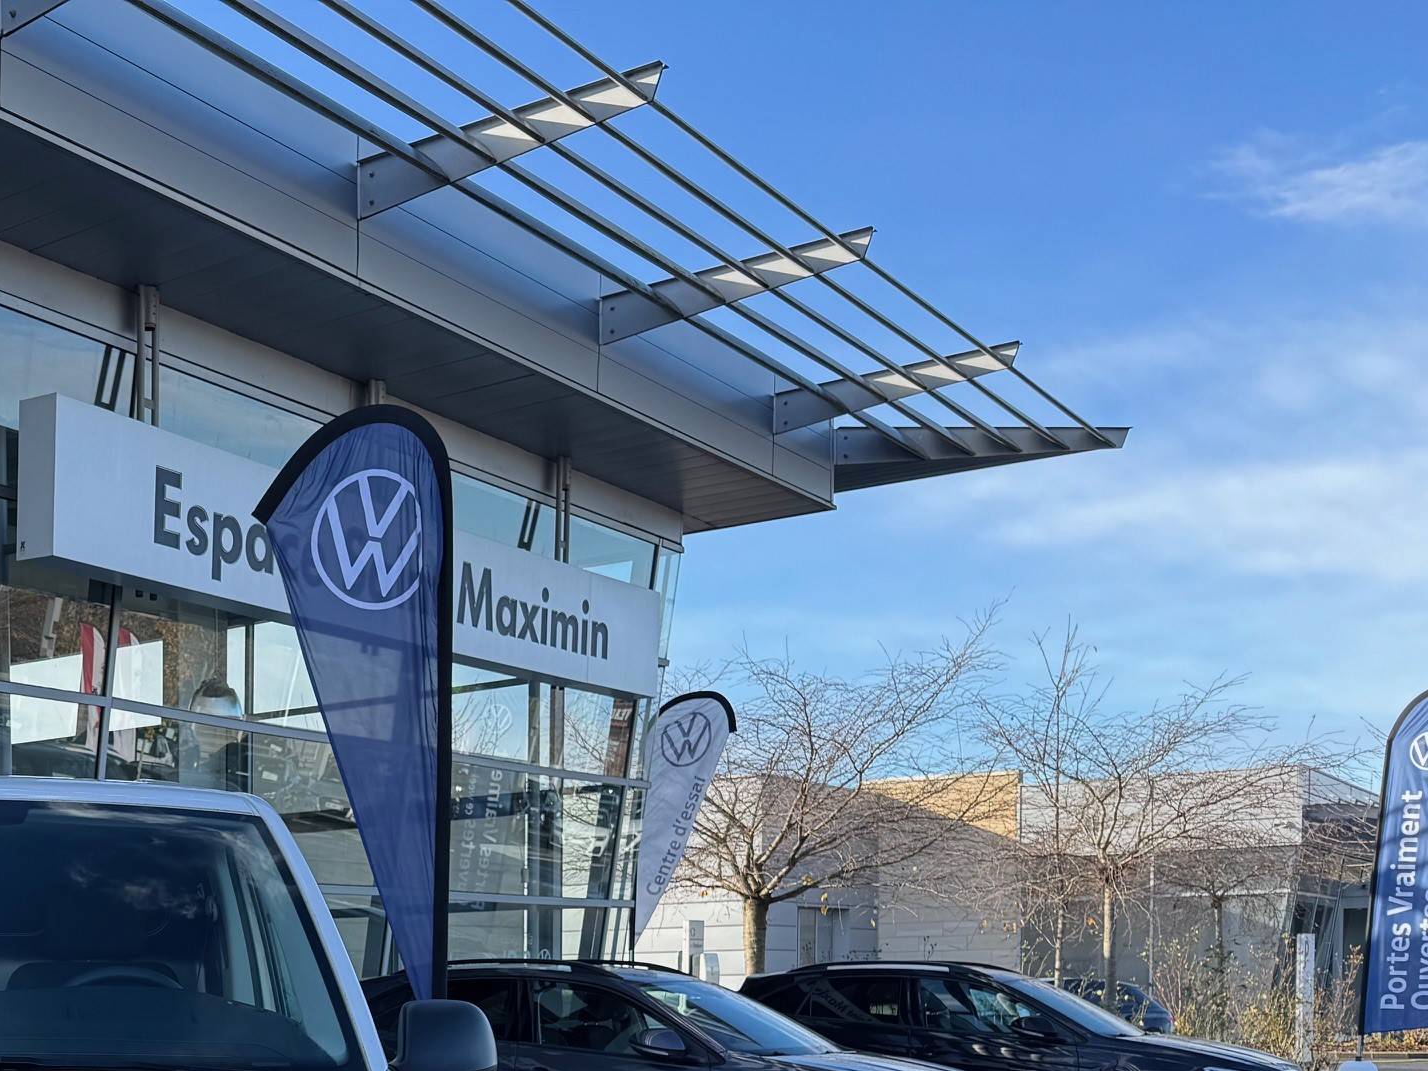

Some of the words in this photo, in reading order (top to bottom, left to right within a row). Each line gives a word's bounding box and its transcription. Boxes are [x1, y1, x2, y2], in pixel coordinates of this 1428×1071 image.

[153, 465, 275, 582] Espa
[456, 561, 609, 660] Maximin
[646, 841, 682, 896] Centre
[672, 776, 706, 837] d'essai
[1386, 790, 1422, 916] Vraiment
[1380, 922, 1412, 1010] Portes
